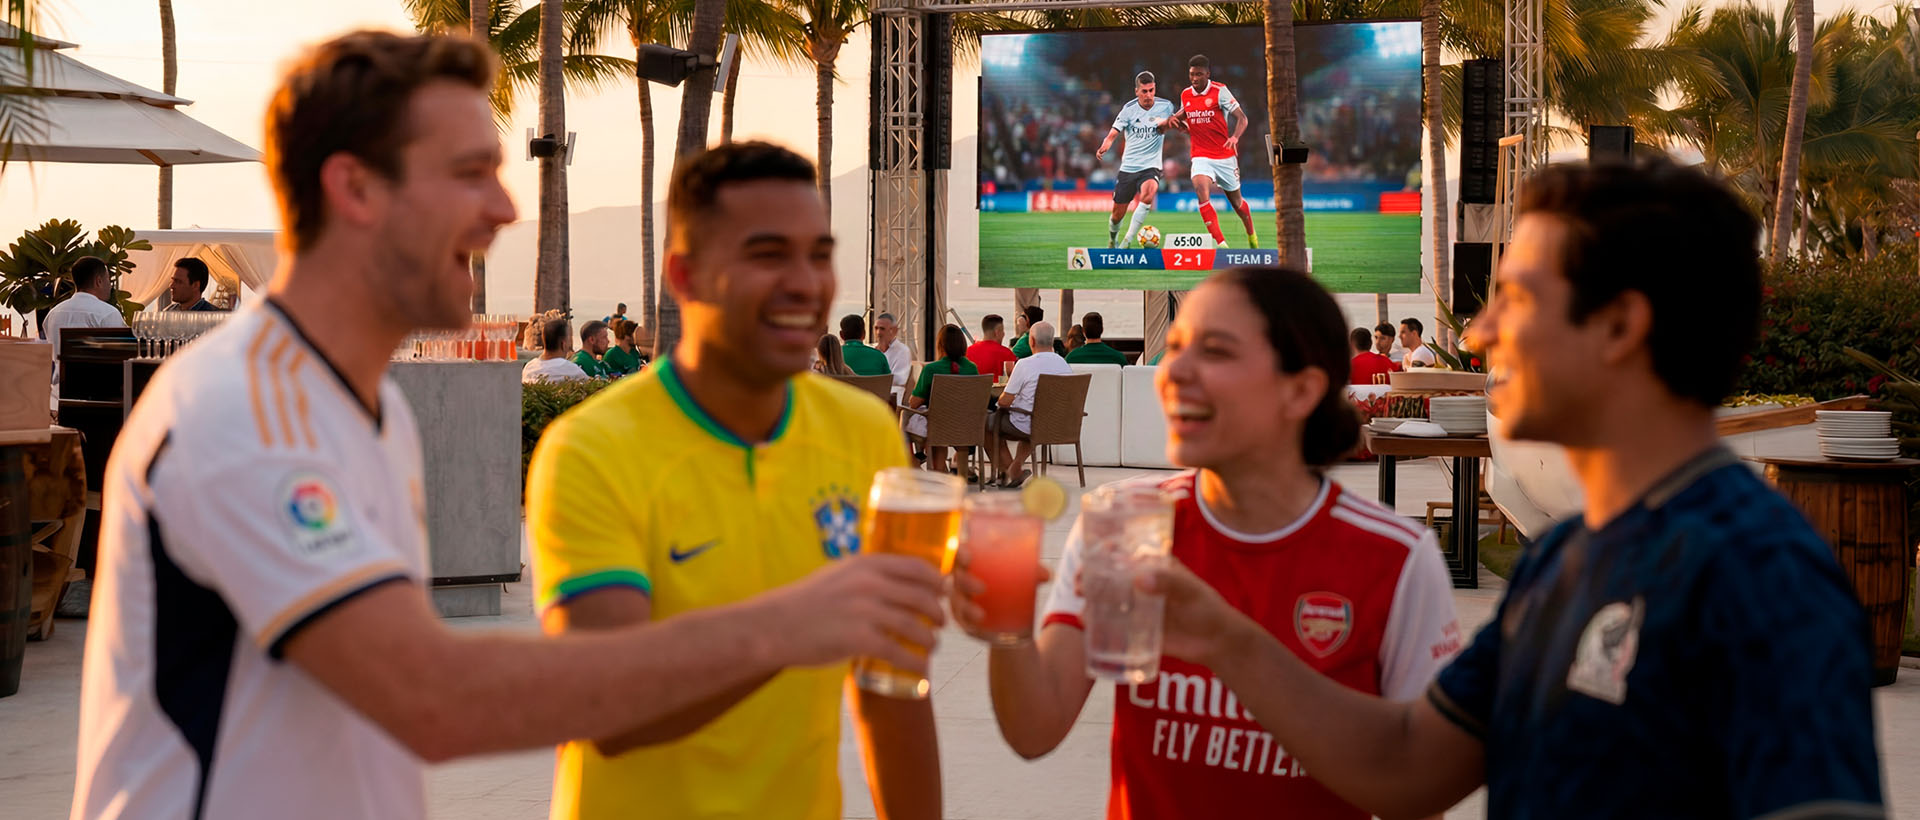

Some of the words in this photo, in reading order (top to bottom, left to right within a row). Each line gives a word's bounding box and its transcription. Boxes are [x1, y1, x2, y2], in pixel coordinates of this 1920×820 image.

[1174, 236, 1203, 247] 65:00
[1100, 254, 1134, 265] TEAM
[1138, 254, 1148, 265] A
[1226, 254, 1261, 265] TEAM
[1264, 254, 1273, 265] B
[1153, 719, 1199, 763] FLY
